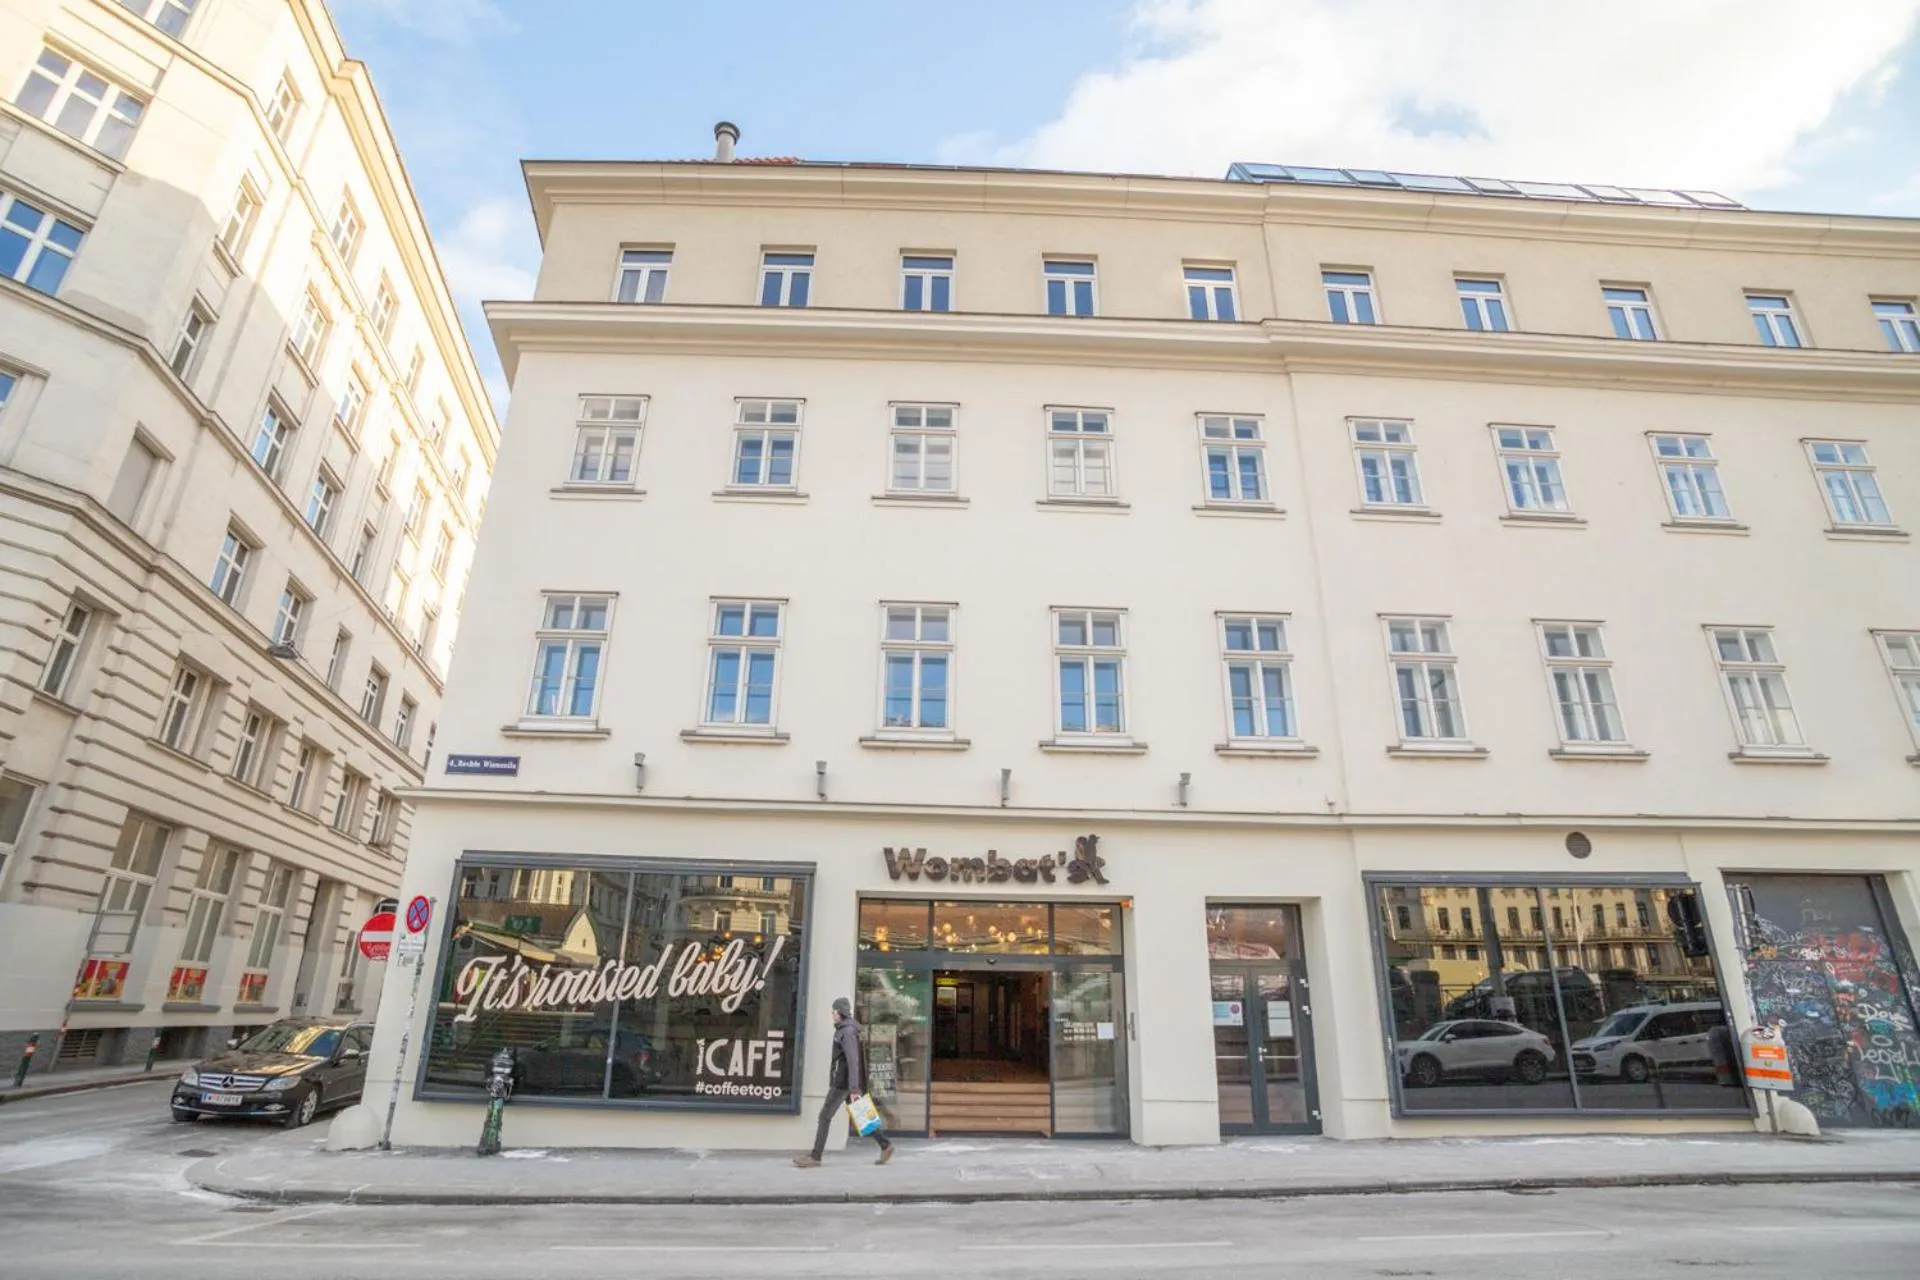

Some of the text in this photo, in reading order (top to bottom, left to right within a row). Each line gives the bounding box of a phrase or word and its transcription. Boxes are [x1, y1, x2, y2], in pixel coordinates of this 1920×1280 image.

[454, 935, 785, 1022] It's roasted baby!
[695, 1080, 783, 1100] #coffeetogo
